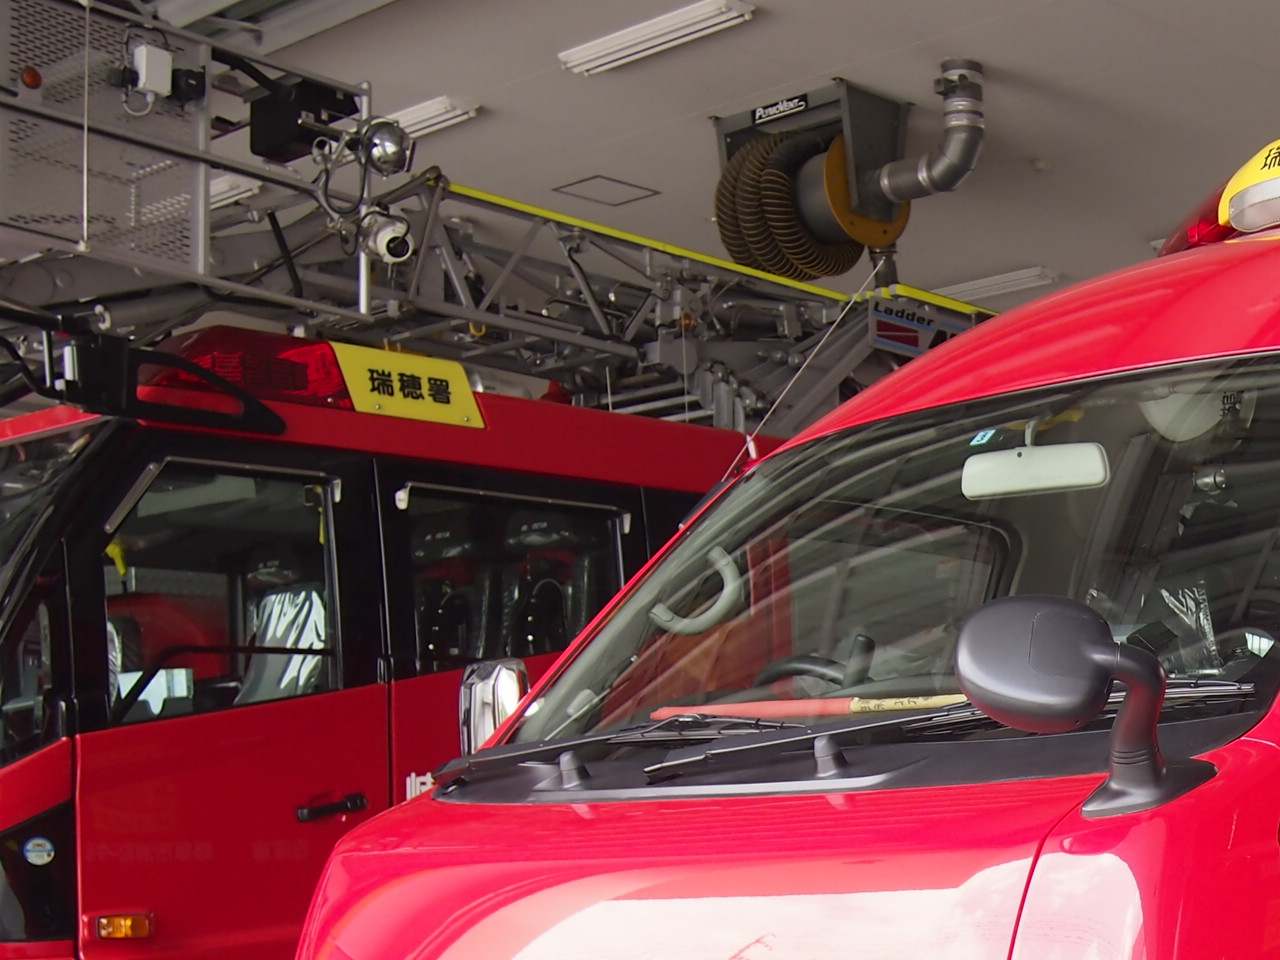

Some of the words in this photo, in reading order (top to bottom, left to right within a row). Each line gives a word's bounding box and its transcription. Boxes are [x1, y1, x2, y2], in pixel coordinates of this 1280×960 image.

[874, 301, 935, 327] Ladder
[367, 368, 452, 405] 瑞穂署
